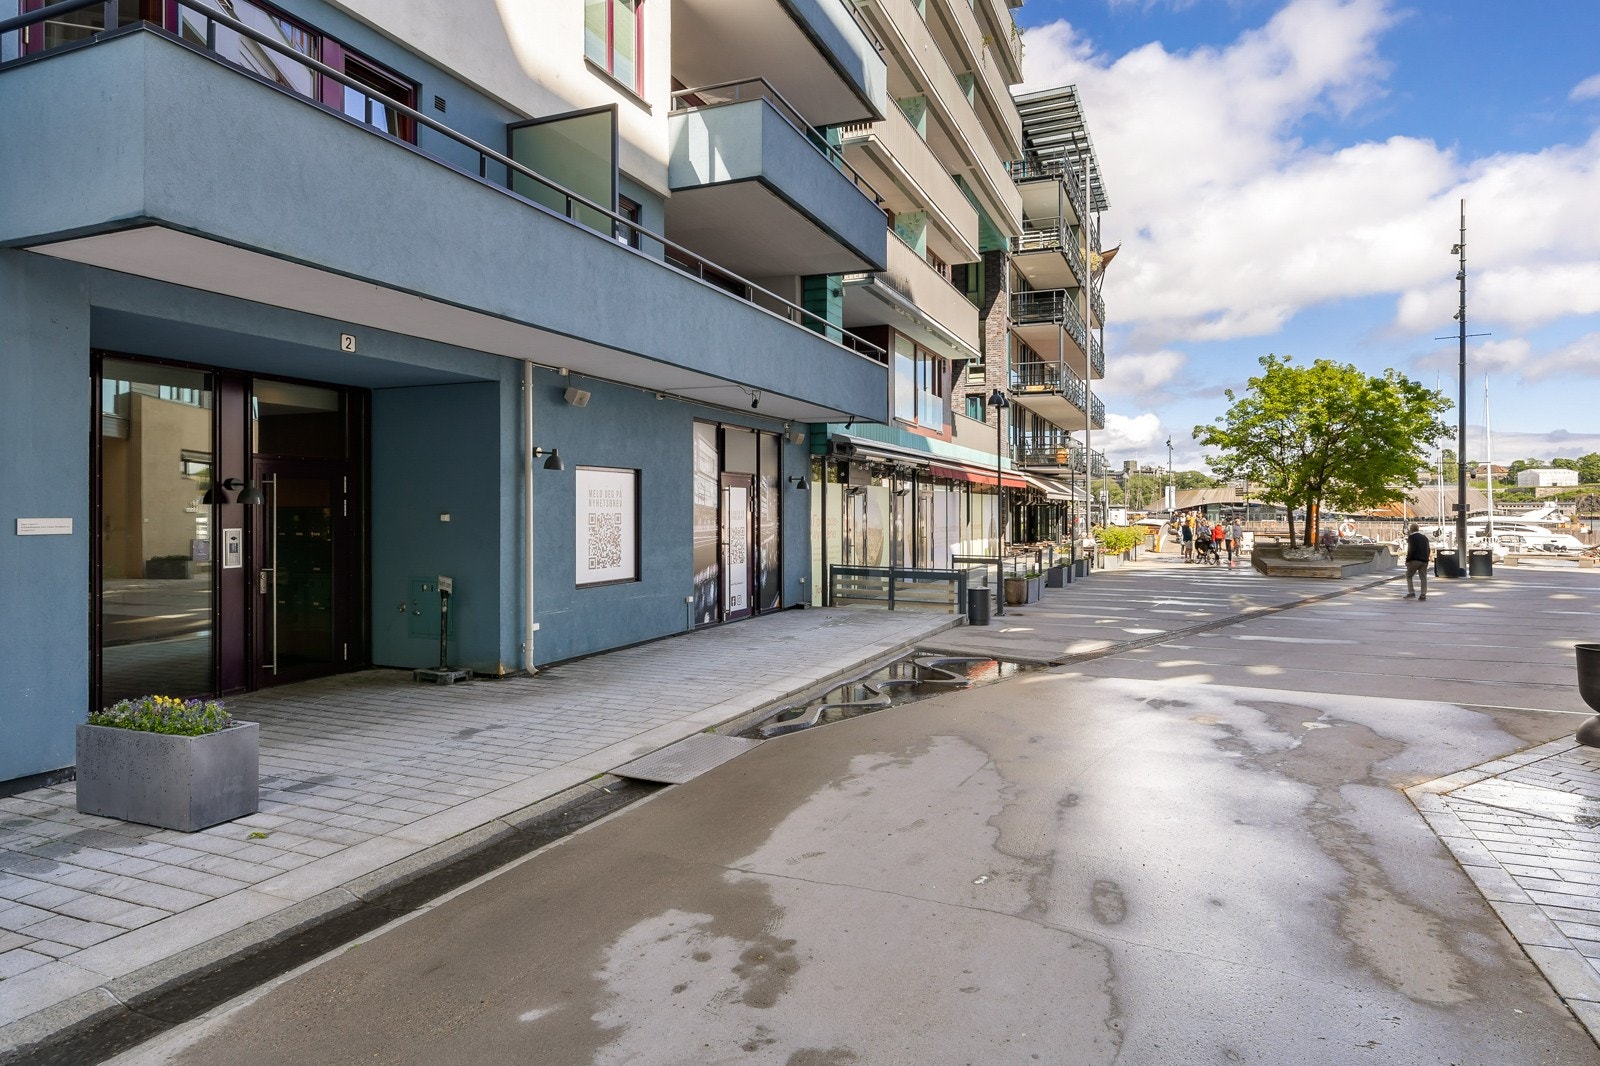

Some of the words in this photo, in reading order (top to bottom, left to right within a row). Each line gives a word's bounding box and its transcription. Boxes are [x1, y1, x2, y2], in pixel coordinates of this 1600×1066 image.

[345, 336, 352, 350] 2
[588, 489, 603, 498] MELD
[604, 489, 615, 499] DEG
[588, 498, 623, 508] NYHETSBREV
